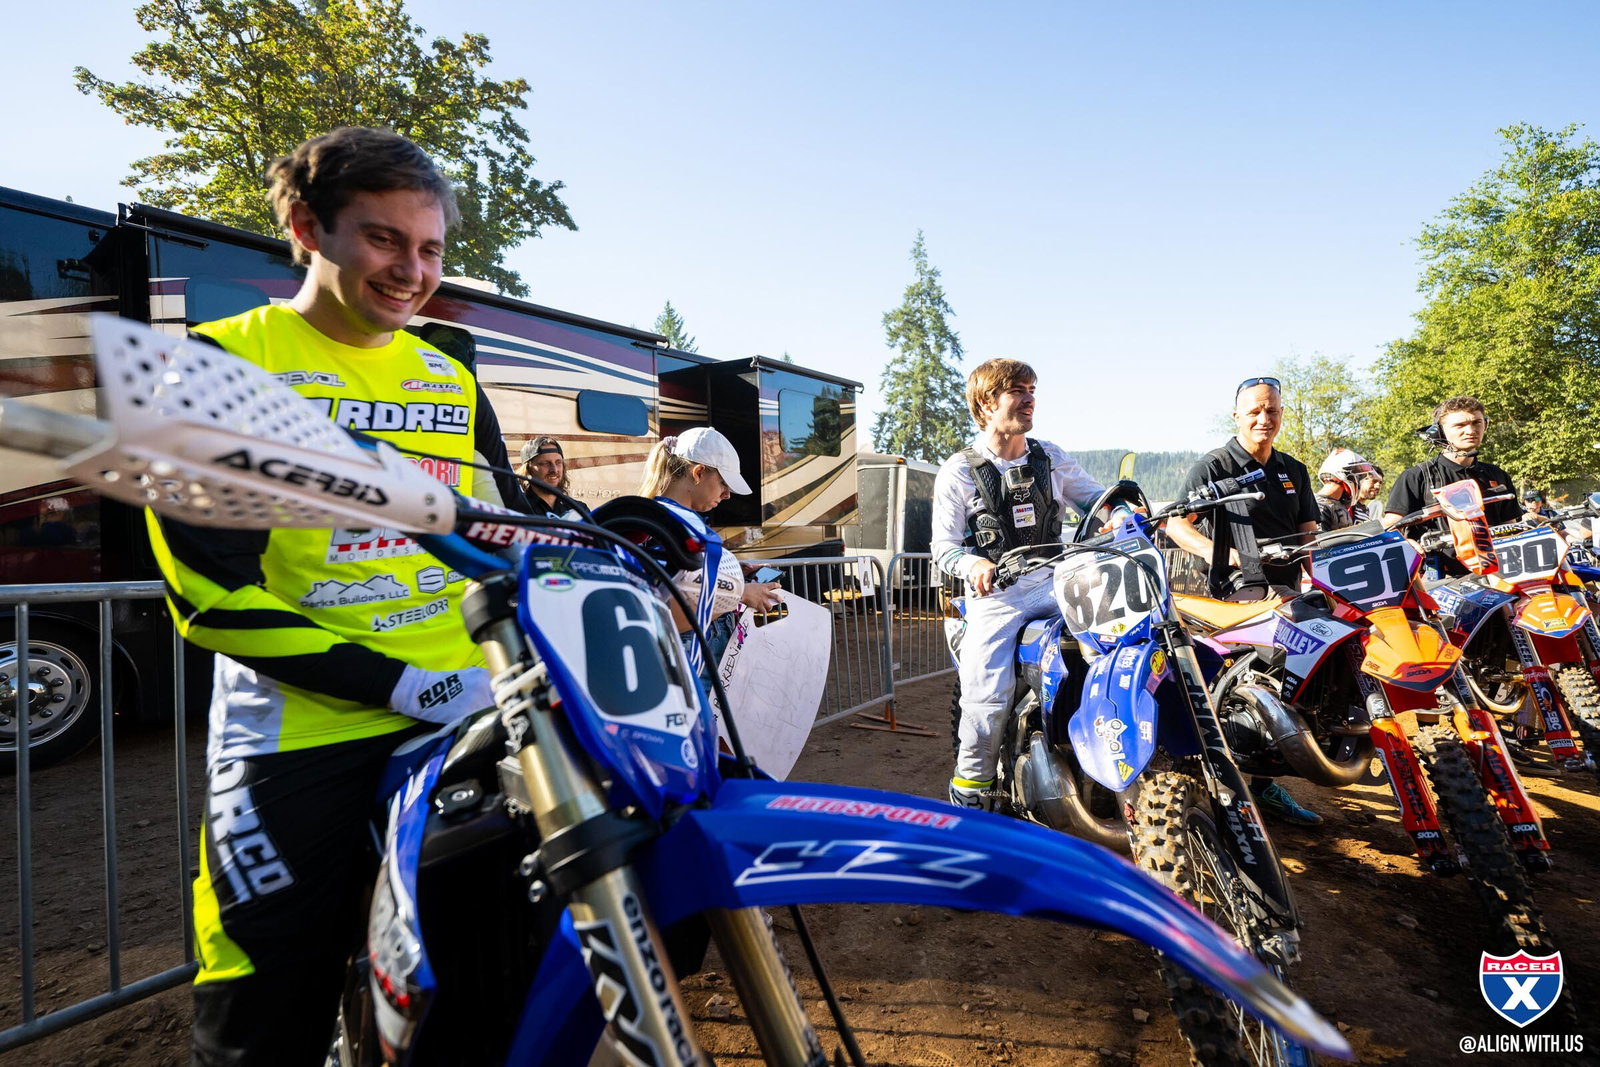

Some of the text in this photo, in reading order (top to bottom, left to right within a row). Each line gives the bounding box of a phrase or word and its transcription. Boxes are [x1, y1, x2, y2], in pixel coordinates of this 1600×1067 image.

[213, 449, 390, 506] ACERBIS
[1328, 545, 1409, 602] 91
[339, 592, 386, 605] Builders
[389, 589, 408, 599] LLC
[1063, 552, 1161, 634] 820
[1276, 624, 1318, 654] VALLEY
[418, 673, 460, 709] RDR
[1549, 711, 1562, 730] EBC
[766, 795, 963, 830] MOTOSPORT
[622, 891, 668, 994] enzo
